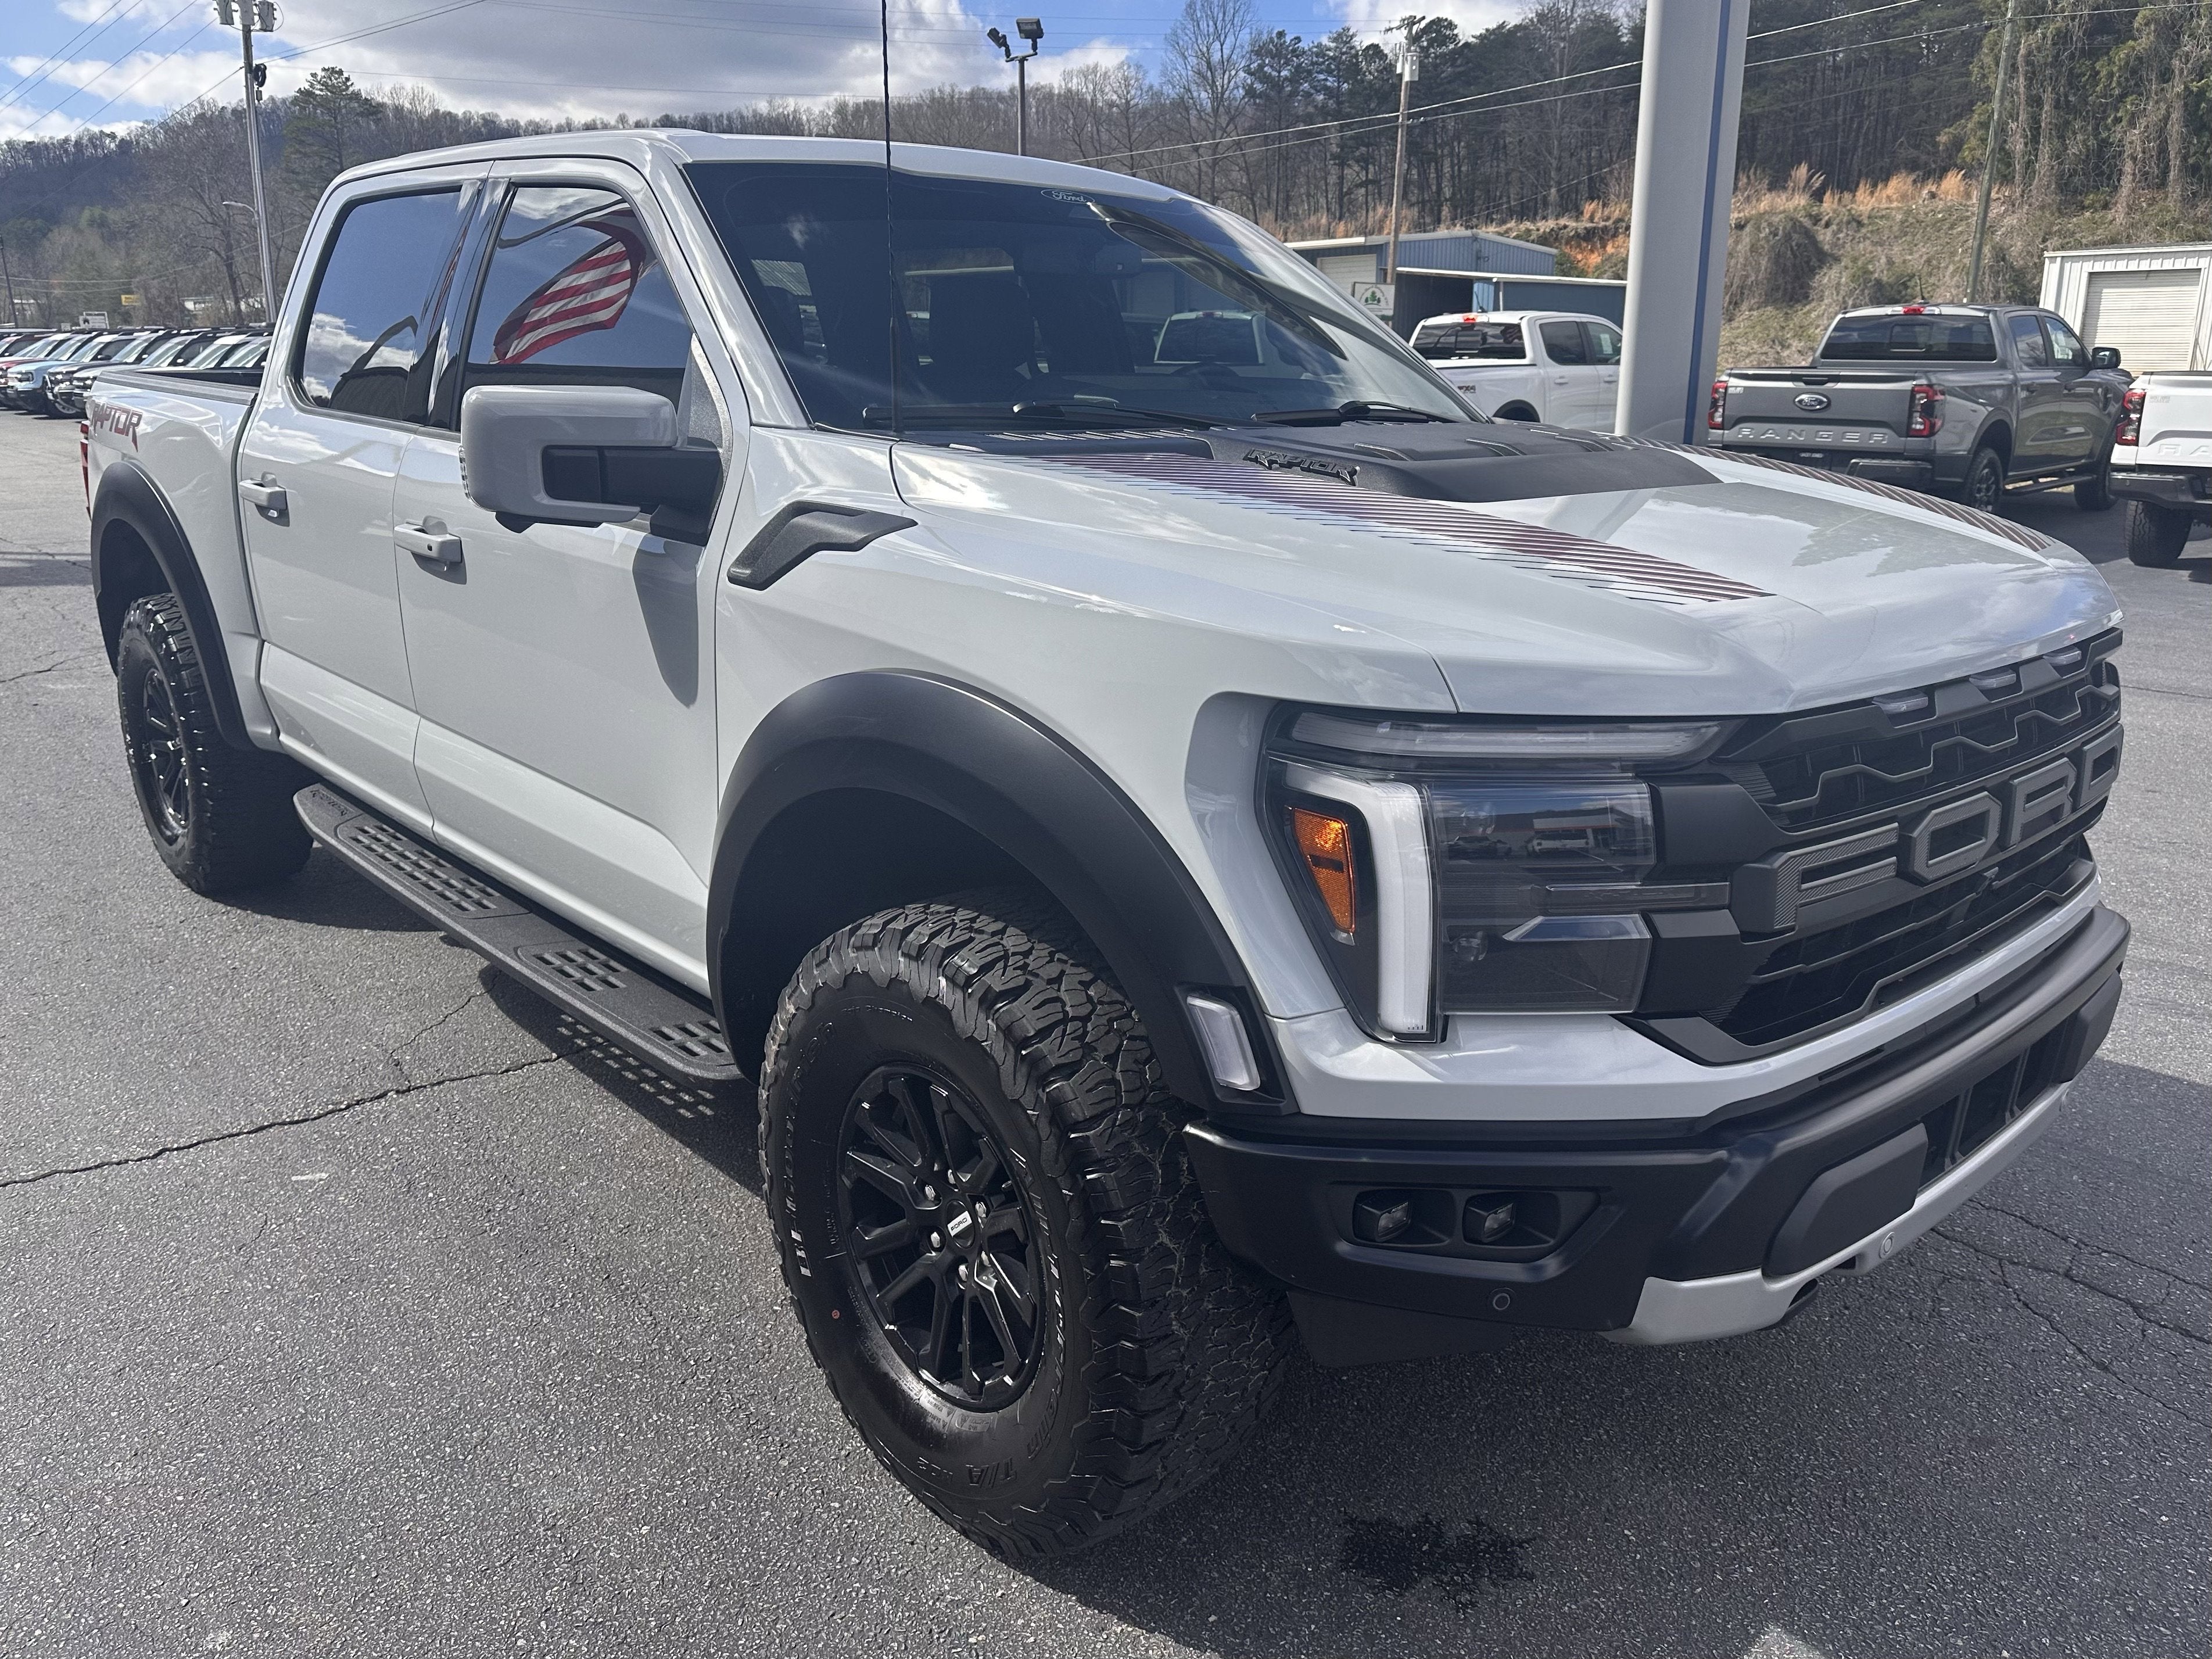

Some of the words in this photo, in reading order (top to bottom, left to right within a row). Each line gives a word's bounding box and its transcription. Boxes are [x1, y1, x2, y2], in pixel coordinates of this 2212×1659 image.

[1052, 191, 1087, 202] Ford
[91, 401, 143, 453] RAPTOR
[1738, 427, 1888, 444] RANGER
[1244, 449, 1358, 486] RAPTOR
[1772, 723, 2124, 930] FORD
[951, 1217, 968, 1232] FORD
